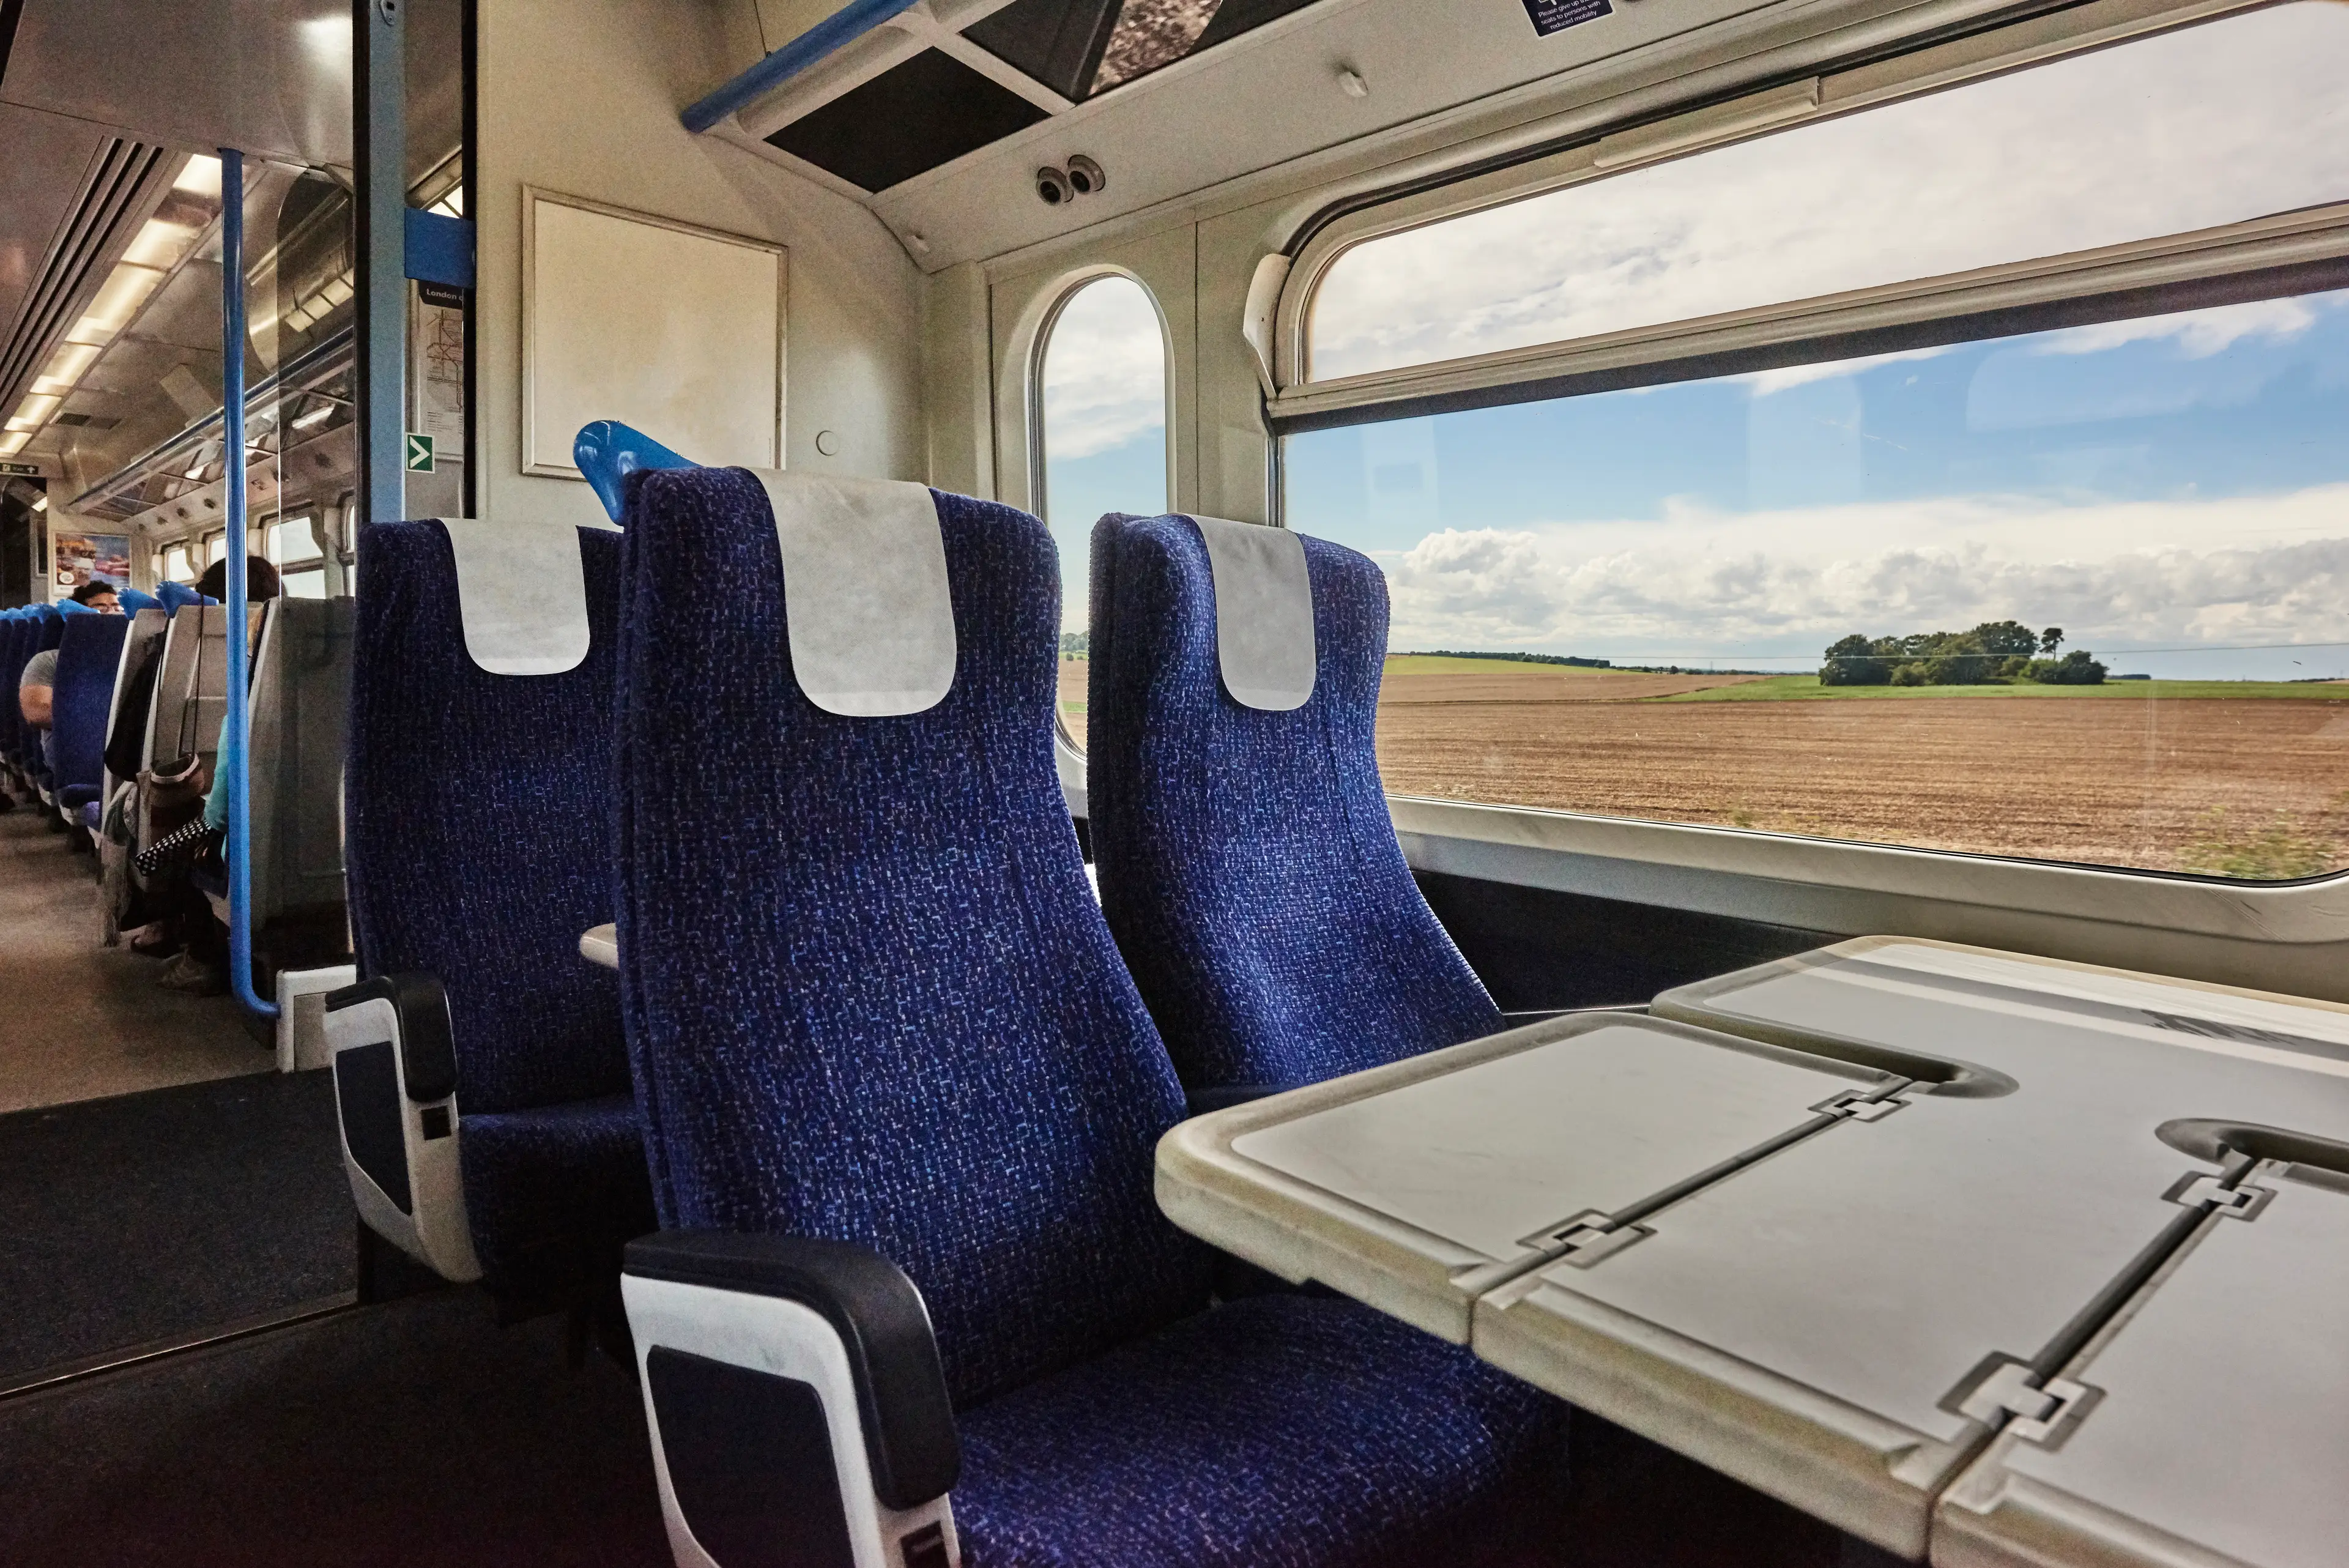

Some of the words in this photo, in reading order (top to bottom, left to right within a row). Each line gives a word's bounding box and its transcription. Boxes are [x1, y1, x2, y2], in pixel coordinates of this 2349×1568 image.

[1538, 9, 1557, 17] Please
[1558, 3, 1570, 12] give
[1541, 16, 1557, 24] seats
[1564, 6, 1587, 17] persons
[1550, 18, 1574, 29] reduced
[1574, 10, 1597, 21] mobility
[426, 288, 457, 300] London
